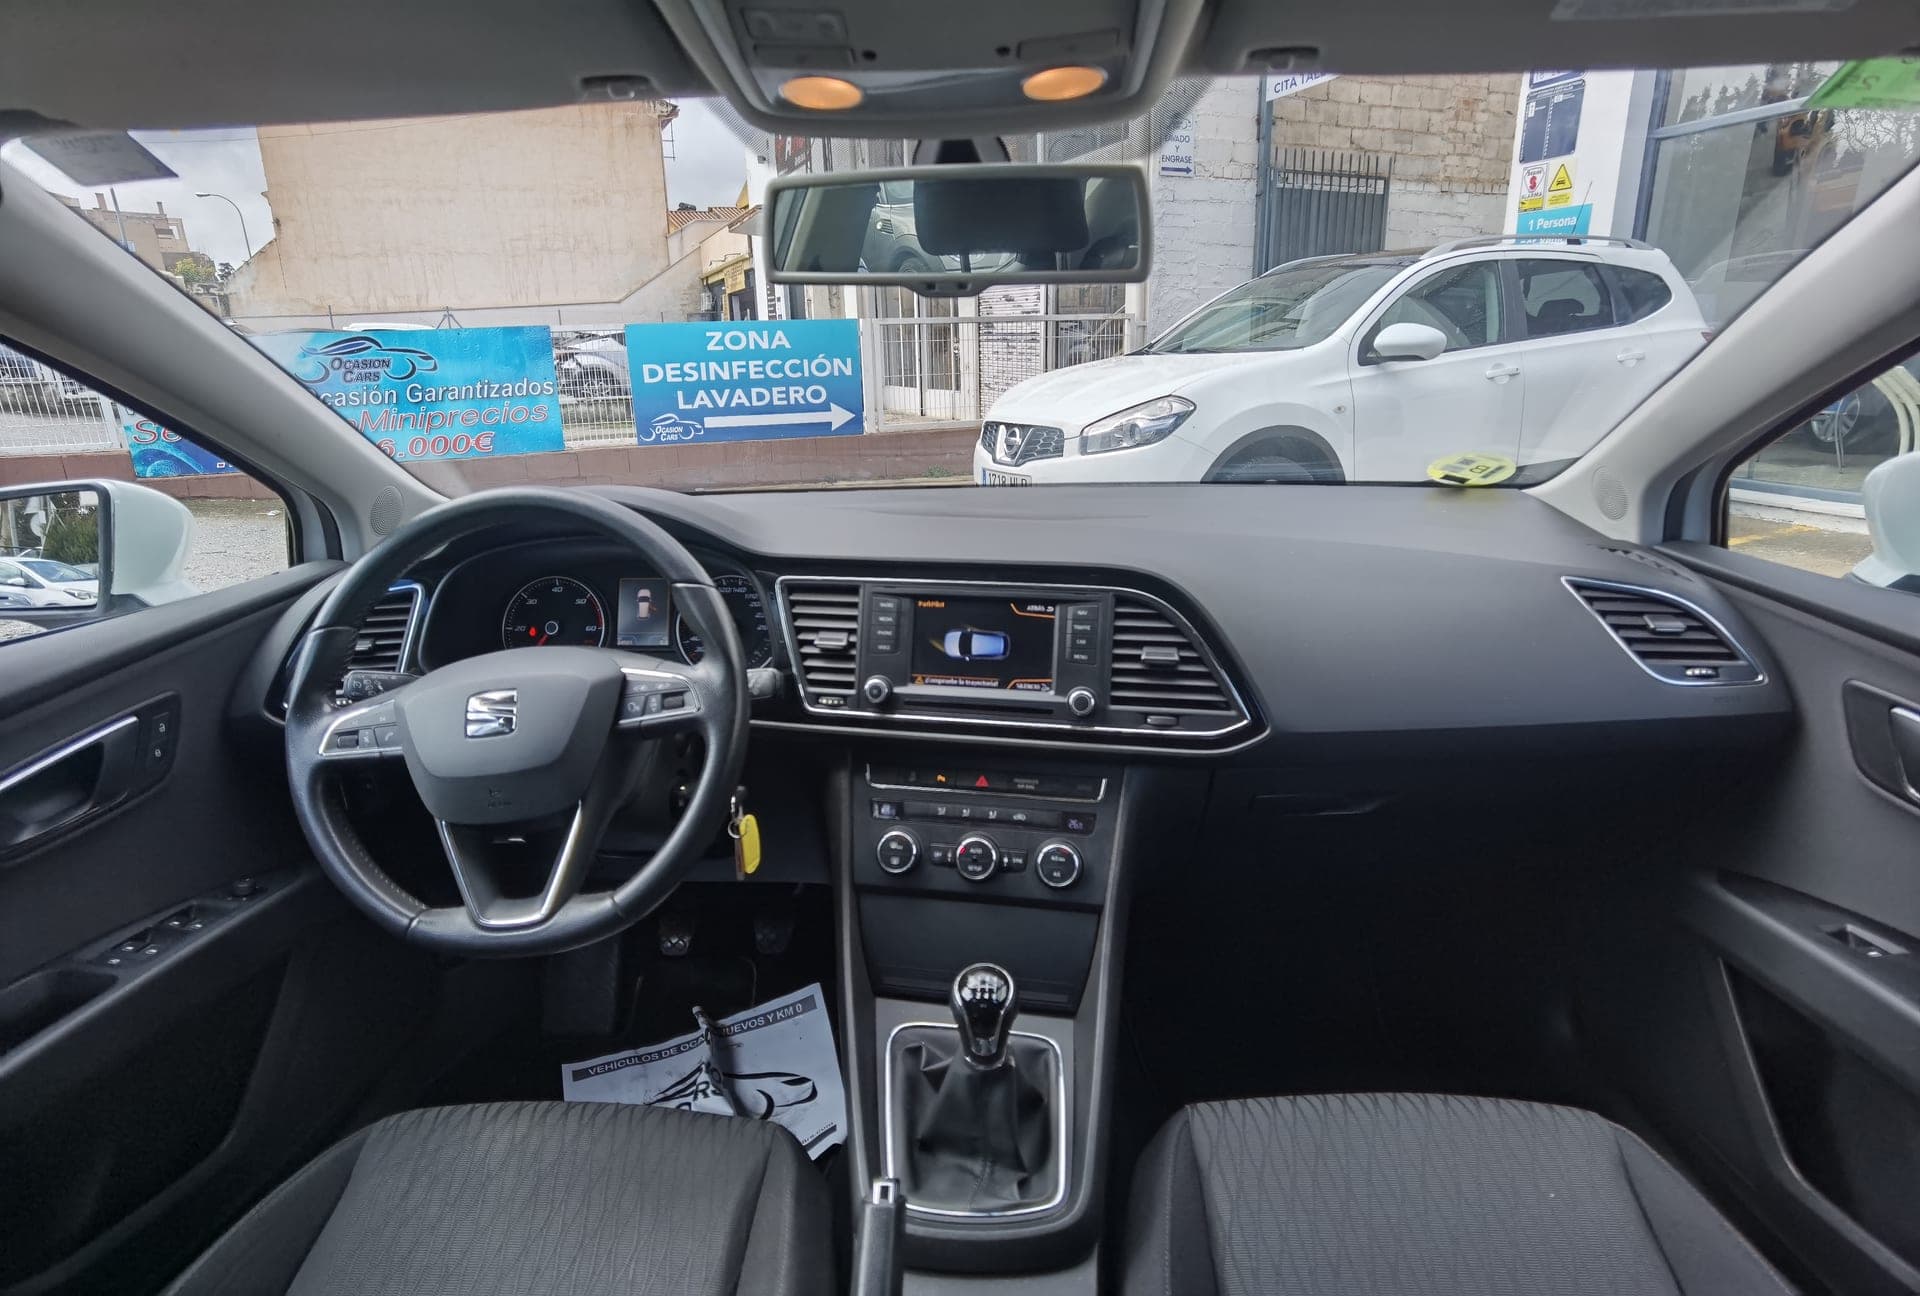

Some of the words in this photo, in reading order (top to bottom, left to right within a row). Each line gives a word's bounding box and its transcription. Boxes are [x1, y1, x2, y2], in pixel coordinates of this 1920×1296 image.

[1274, 77, 1298, 94] CITA
[1161, 154, 1193, 164] ENGRASE
[1536, 216, 1577, 230] Persona
[705, 330, 792, 351] ZONA
[330, 357, 391, 372] OCASION
[642, 353, 853, 384] DESINFECCIÓN
[342, 370, 381, 384] CARS
[312, 383, 397, 408] casión
[406, 376, 554, 404] Garantizados
[677, 385, 828, 410] LAVADERO
[357, 402, 548, 434] Miniprecios
[655, 425, 683, 435] OCASION
[660, 432, 679, 442] CARS
[662, 1048, 678, 1058] DE
[776, 1007, 793, 1020] KM
